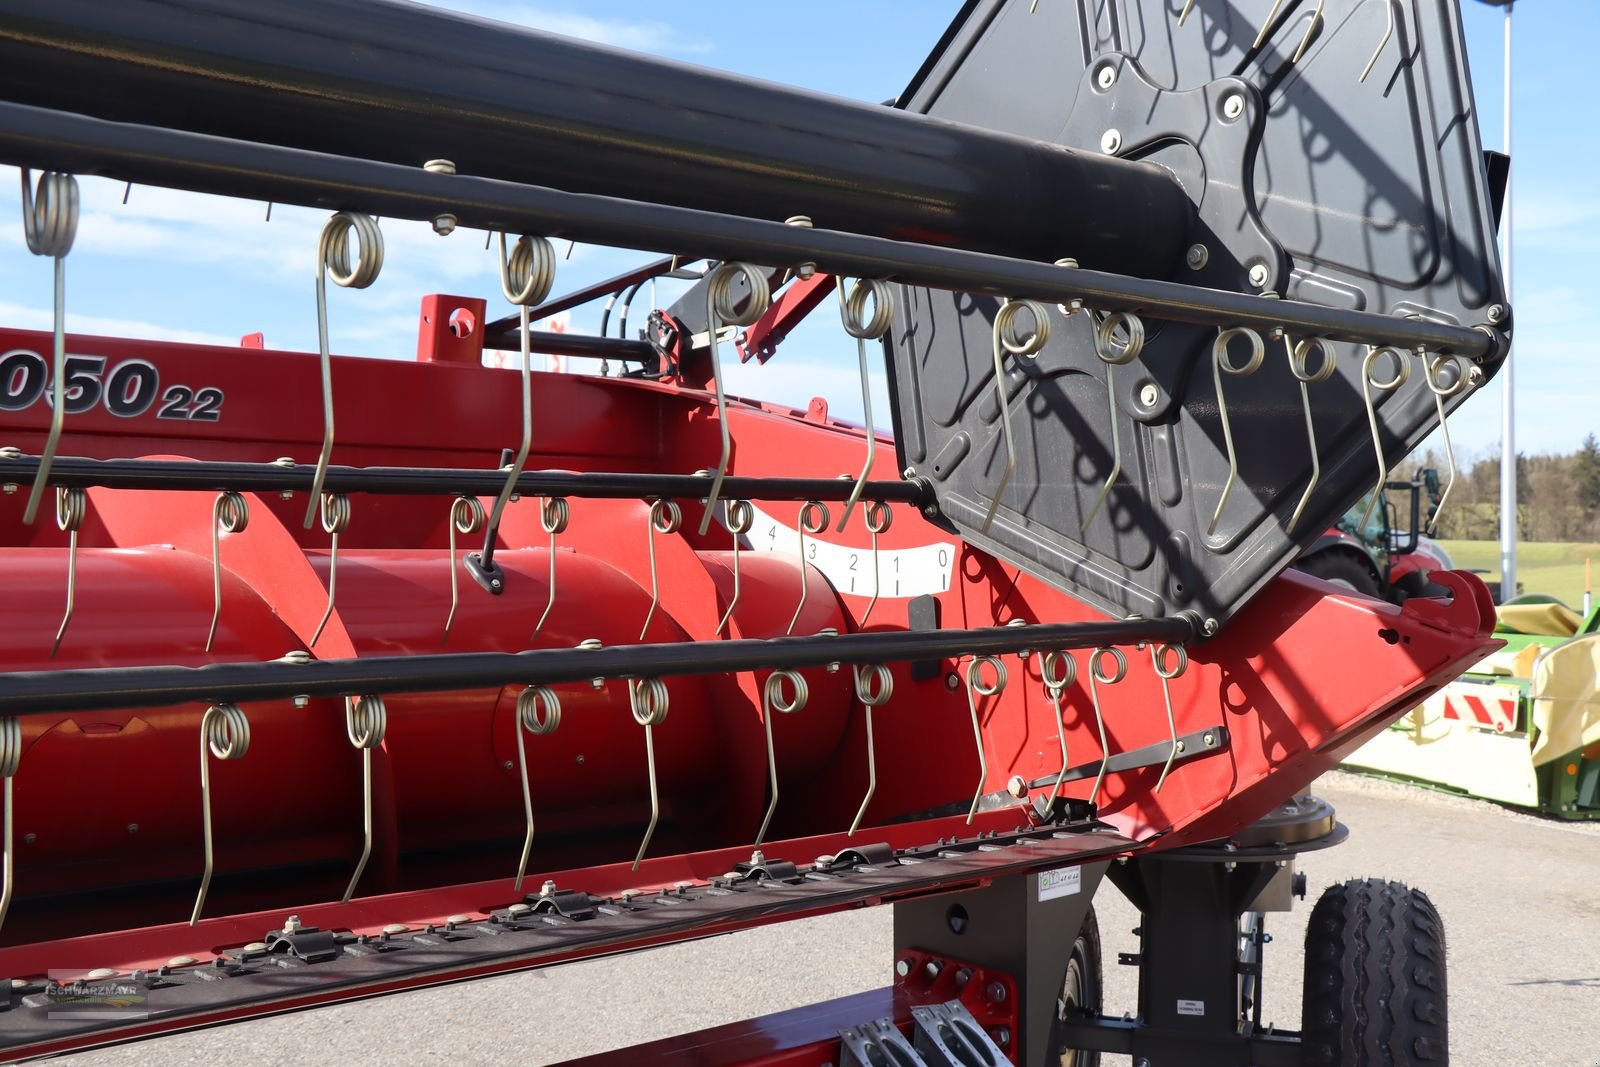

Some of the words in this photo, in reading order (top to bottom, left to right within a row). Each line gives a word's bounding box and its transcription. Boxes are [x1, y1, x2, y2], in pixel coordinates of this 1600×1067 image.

[156, 385, 224, 422] 22
[768, 525, 777, 541] 4
[809, 543, 817, 559] 3
[849, 554, 858, 571] 2
[893, 556, 899, 573] 1
[938, 549, 948, 567] 0
